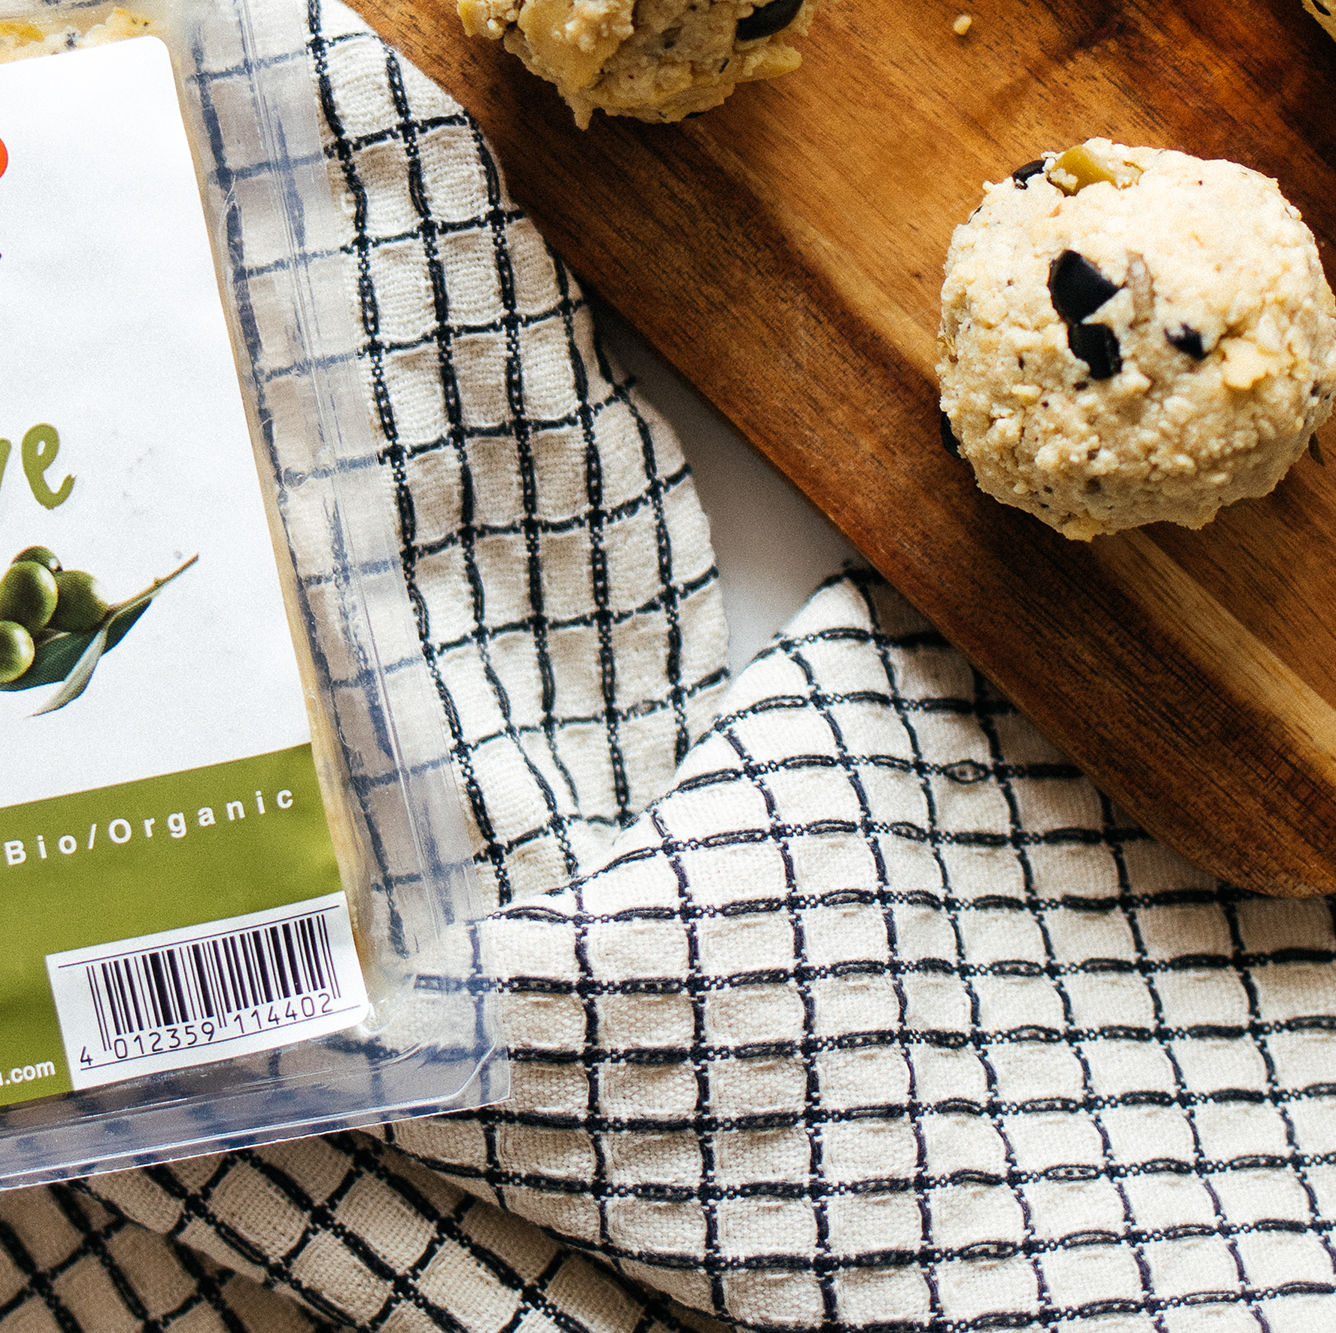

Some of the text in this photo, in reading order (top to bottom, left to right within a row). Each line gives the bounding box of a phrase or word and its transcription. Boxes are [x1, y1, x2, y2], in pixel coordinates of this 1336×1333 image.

[3, 787, 295, 866] Bio/Organic
[79, 992, 334, 1067] 4 012359 114402
